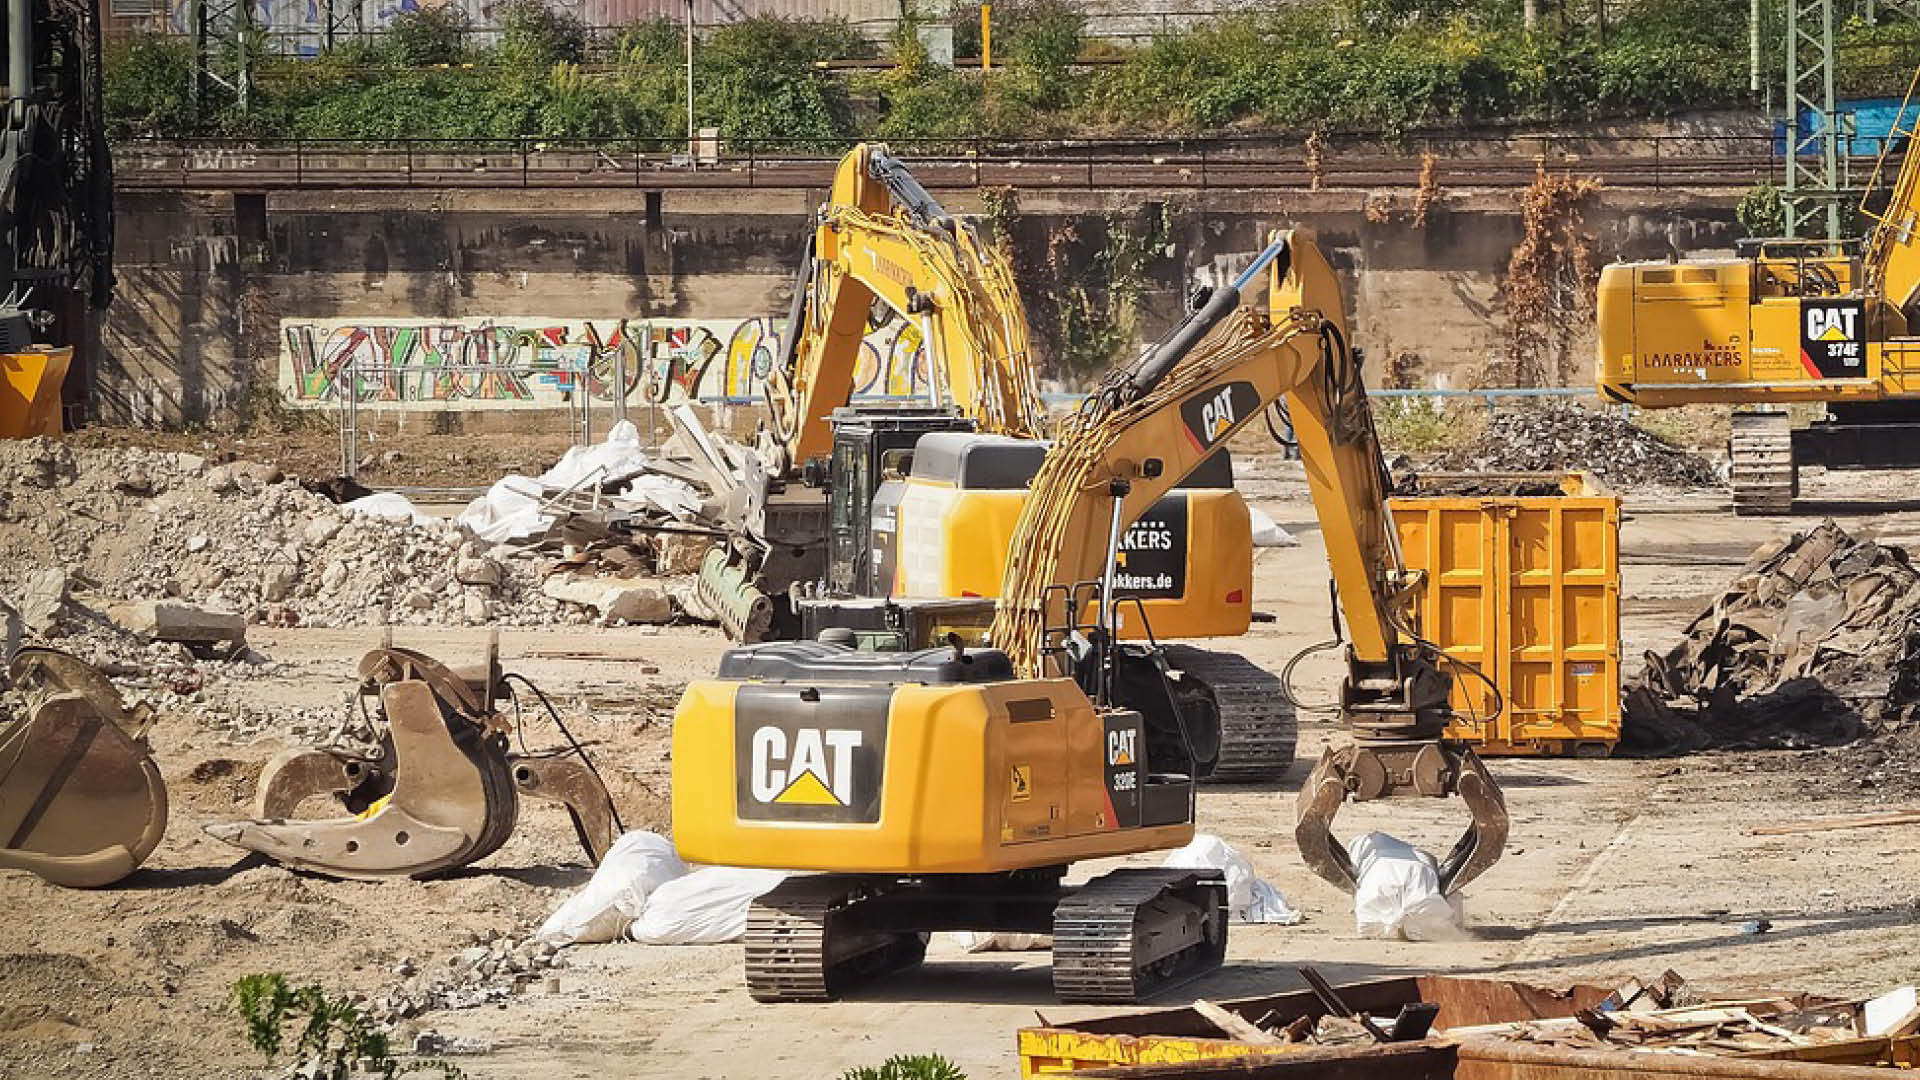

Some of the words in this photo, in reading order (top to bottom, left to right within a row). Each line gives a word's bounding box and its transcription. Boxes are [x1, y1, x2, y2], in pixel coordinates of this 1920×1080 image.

[1807, 307, 1859, 341] CAT
[1644, 351, 1742, 368] LAARAKKERS
[1202, 385, 1235, 442] CAT
[752, 726, 862, 806] CAT
[1108, 728, 1137, 766] CAT
